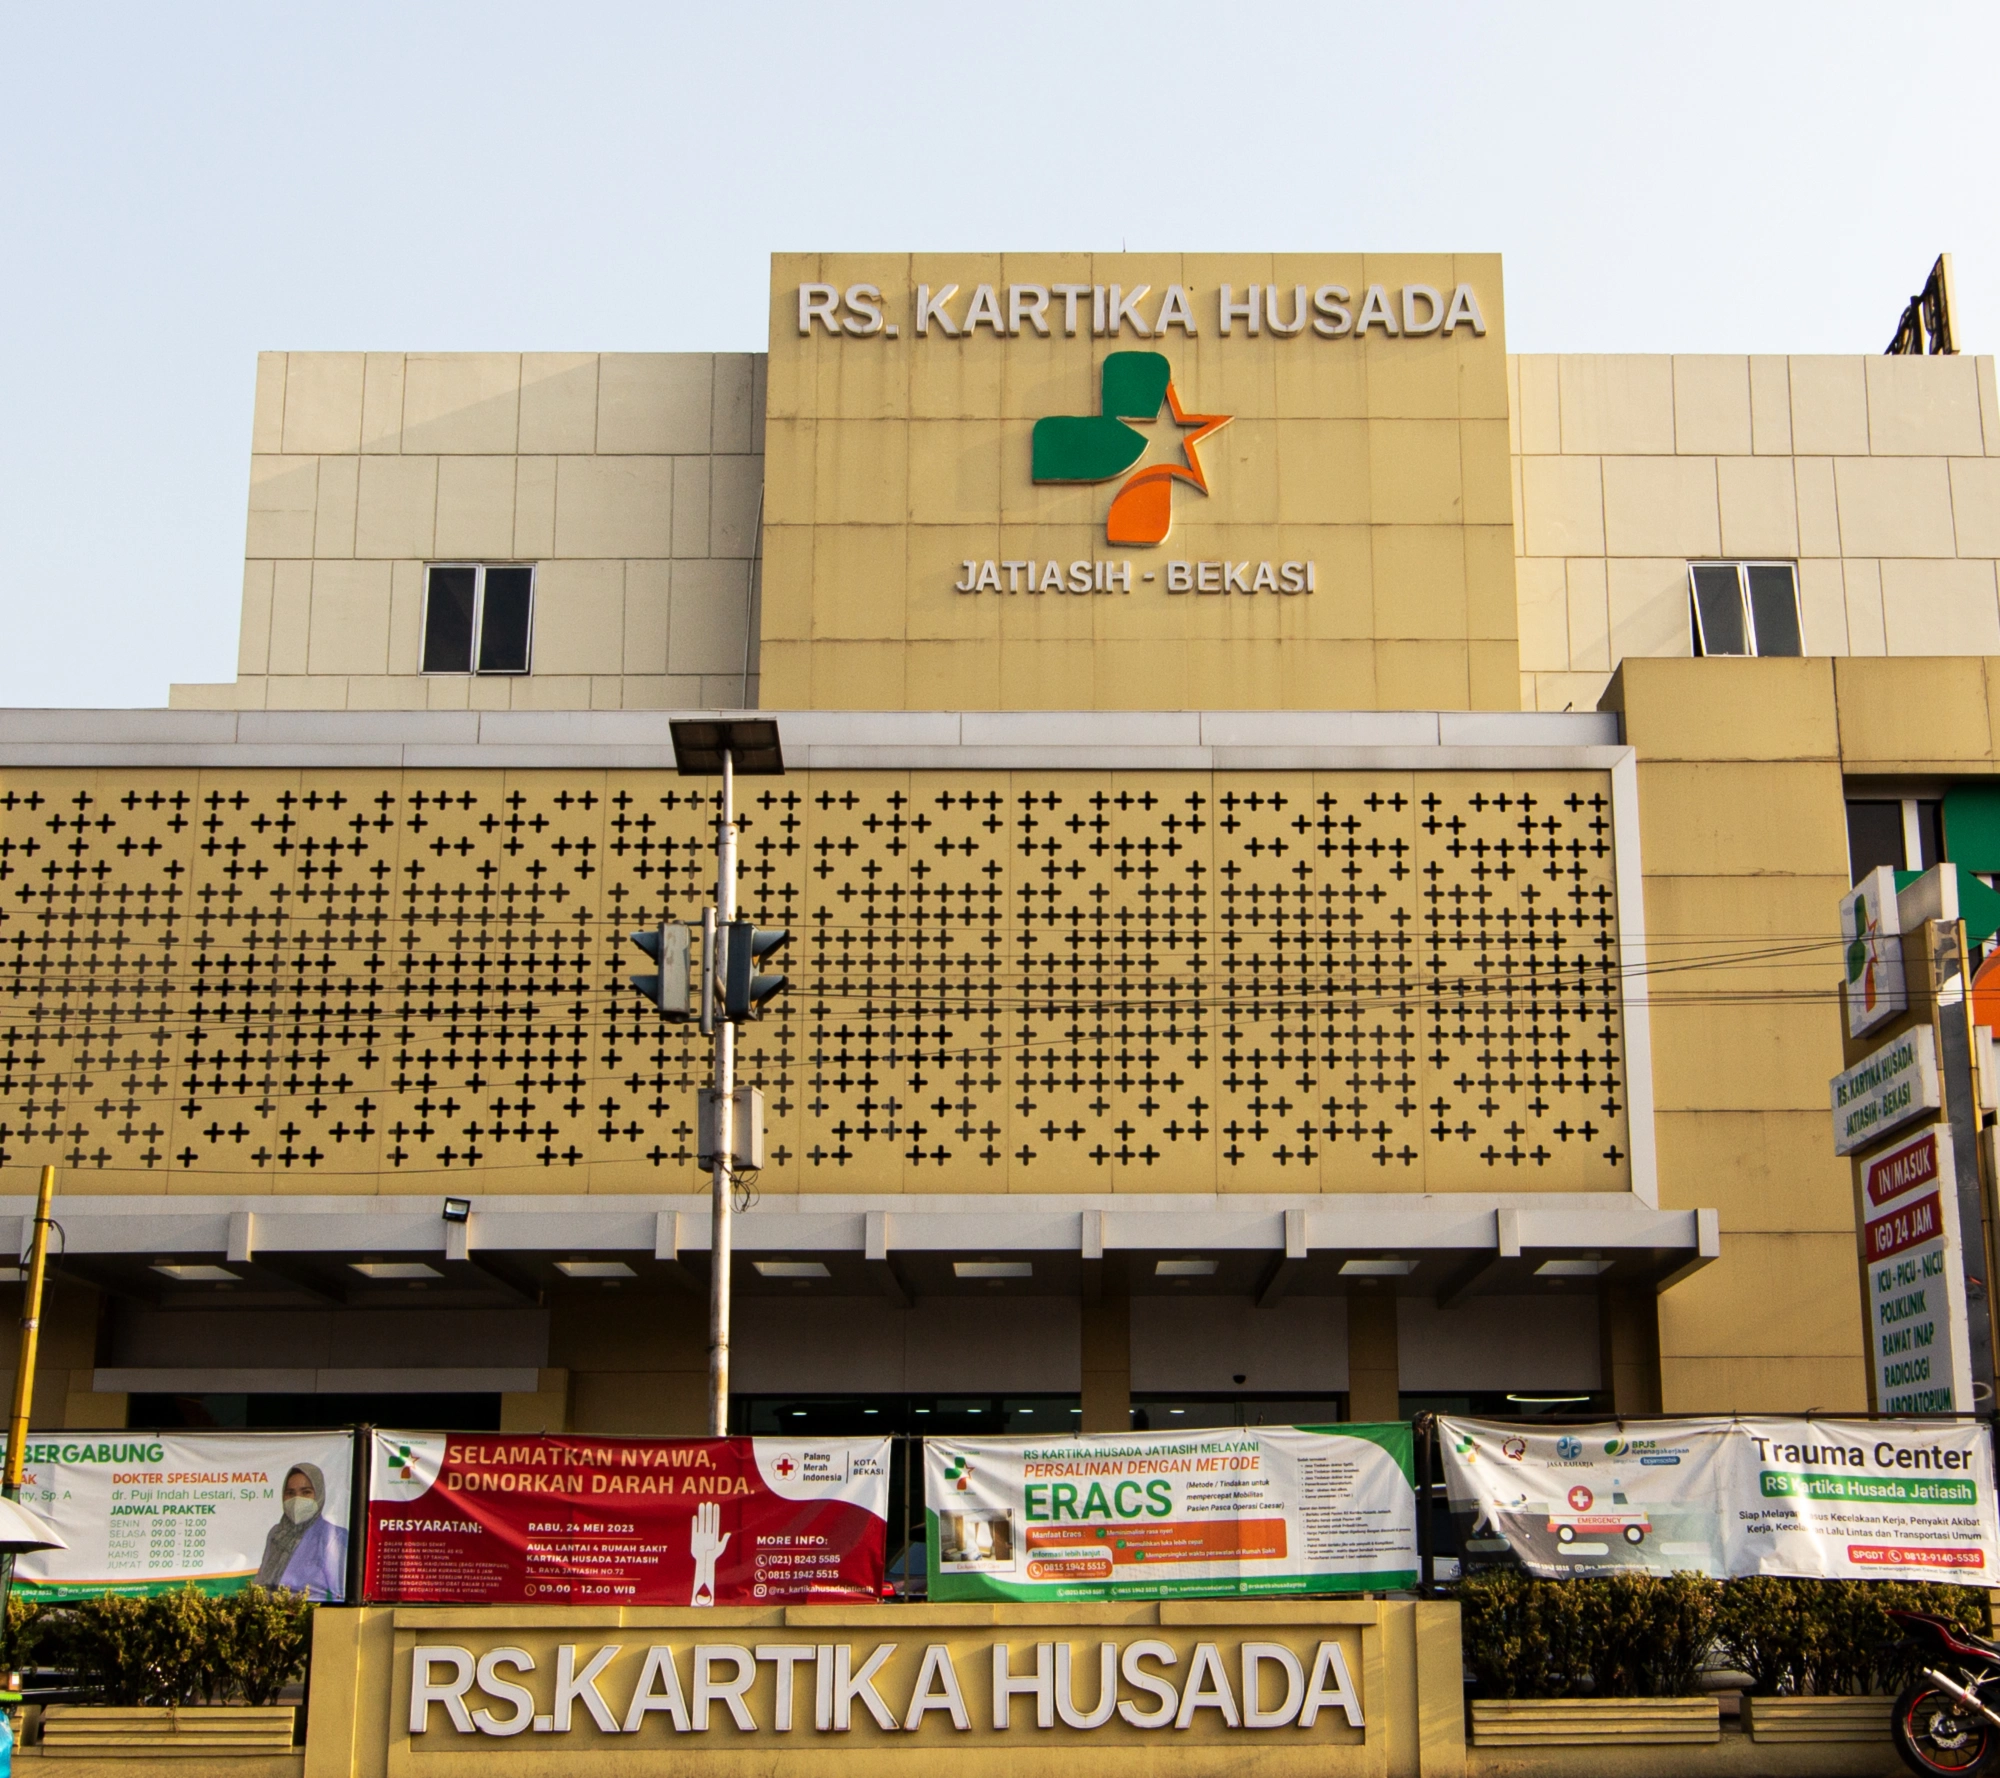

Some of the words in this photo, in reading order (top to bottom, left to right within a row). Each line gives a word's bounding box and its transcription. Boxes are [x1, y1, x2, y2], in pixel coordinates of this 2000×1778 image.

[799, 283, 899, 338] RS.
[916, 283, 1198, 338] KARTIKA
[1220, 283, 1487, 338] HUSADA
[956, 560, 1132, 595] JATIASIH
[1167, 560, 1316, 595] BEKASI
[1850, 1066, 1881, 1101] KARTIKA
[1881, 1043, 1914, 1081] HUSADA
[1846, 1103, 1878, 1137] JATIASIH
[1883, 1081, 1911, 1113] BEKASI
[1878, 1145, 1931, 1196] IN/MASUK
[1875, 1222, 1893, 1253] IGD
[1895, 1215, 1909, 1246] 24
[1911, 1204, 1933, 1238] JAM
[1877, 1268, 1891, 1293] ICU
[1897, 1259, 1916, 1286] PICU
[1922, 1250, 1943, 1280] NICU
[1880, 1289, 1927, 1326] POLIKLINIK
[1882, 1328, 1911, 1357] RAWAT
[1913, 1321, 1934, 1348] INAP
[1884, 1356, 1930, 1388] RADIOLOGI
[1023, 1450, 1039, 1460] RS
[1041, 1448, 1092, 1460] KARTIKA
[1095, 1446, 1143, 1458] HUSADA
[1145, 1444, 1198, 1457] JATIASIH
[1200, 1441, 1260, 1455] MELAYANI
[1631, 1440, 1656, 1449] BPJS
[24, 1443, 164, 1464] BERGABUNG
[803, 1452, 831, 1462] Palang
[1631, 1447, 1690, 1456] Ketenagakerjaan
[1752, 1437, 1865, 1468] Trauma
[1874, 1441, 1973, 1470] Center
[448, 1445, 612, 1467] SELAMATKAN
[621, 1449, 717, 1471] NYAWA,
[803, 1463, 828, 1472] Merah
[853, 1468, 884, 1476] BEKASI
[1024, 1460, 1123, 1478] PERSALINAN
[1132, 1458, 1192, 1475] DENGAN
[1195, 1456, 1261, 1472] METODE
[112, 1473, 163, 1484] DOKTER
[166, 1472, 229, 1484] SPESIALIS
[231, 1472, 268, 1483] MATA
[803, 1473, 842, 1482] Indonesia
[447, 1472, 583, 1494] DONORKAN
[591, 1474, 674, 1495] DARAH
[681, 1476, 756, 1496] ANDA.
[1186, 1480, 1214, 1490] (Metode
[1220, 1479, 1250, 1488] Tindakan
[1251, 1478, 1270, 1487] untuk
[1765, 1476, 1788, 1491] RS
[1791, 1478, 1844, 1496] Kartika
[1848, 1480, 1906, 1499] Husada
[1910, 1483, 1973, 1500] Jatiasih
[63, 1490, 71, 1500] A
[112, 1489, 127, 1501] dr.
[131, 1489, 154, 1504] Puji
[157, 1489, 190, 1500] Indah
[194, 1489, 235, 1502] Lestari,
[240, 1489, 259, 1503] Sp.
[263, 1488, 274, 1499] M
[1025, 1479, 1173, 1521] ERACS
[1186, 1492, 1232, 1502] mempercepat
[1233, 1491, 1264, 1500] Mobilitas
[110, 1505, 159, 1516] JADWAL
[163, 1504, 216, 1515] PRAKTEK
[1186, 1503, 1209, 1512] Pasien
[1210, 1503, 1231, 1512] Pasca
[1232, 1502, 1258, 1512] Operasi
[1260, 1501, 1285, 1511] Caesar)
[110, 1519, 140, 1528] SENIN
[1577, 1517, 1622, 1525] EMERGENCY
[1738, 1510, 1760, 1521] Siap
[1831, 1513, 1881, 1524] Kecelakaan
[1882, 1515, 1908, 1526] Kerja,
[1910, 1516, 1950, 1528] Penyakit
[1951, 1517, 1980, 1526] Akibat
[379, 1519, 483, 1534] PERSYARATAN:
[528, 1522, 563, 1533] RABU,
[566, 1523, 580, 1533] 24
[583, 1523, 604, 1533] MEI
[607, 1524, 634, 1533] 2023
[1746, 1523, 1774, 1534] Kerja,
[1826, 1527, 1845, 1536] Lalu
[1846, 1527, 1873, 1538] Lintas
[1875, 1528, 1892, 1538] dan
[1893, 1530, 1951, 1541] Transportasi
[1952, 1531, 1982, 1541] Umum
[109, 1530, 146, 1538] SELASA
[756, 1535, 791, 1545] MORE
[795, 1536, 828, 1545] INFO:
[1032, 1530, 1062, 1539] Manfaat
[108, 1540, 135, 1548] RABU
[526, 1543, 553, 1552] AULA
[555, 1543, 591, 1552] LANTAI
[593, 1544, 599, 1552] 4
[601, 1544, 637, 1553] RUMAH
[639, 1544, 668, 1553] SAKIT
[526, 1554, 569, 1563] KARTIKA
[571, 1555, 612, 1564] HUSADA
[614, 1556, 659, 1564] JATIASIH
[768, 1554, 792, 1566] (021)
[794, 1555, 817, 1564] 8243
[819, 1554, 840, 1564] 5585
[1852, 1550, 1884, 1560] SPGDT
[1904, 1552, 1980, 1563] 0812-9140-5535
[562, 1567, 599, 1575] JATIASIH
[1043, 1563, 1064, 1572] 0815
[1066, 1562, 1086, 1571] 1942
[1087, 1561, 1107, 1570] 5515
[768, 1570, 791, 1580] 0815
[793, 1570, 814, 1579] 1942
[816, 1569, 839, 1579] 5515
[539, 1584, 571, 1593] 09.00
[580, 1585, 611, 1594] 12.00
[613, 1586, 636, 1594] WIB
[993, 1641, 1365, 1730] HUSADA
